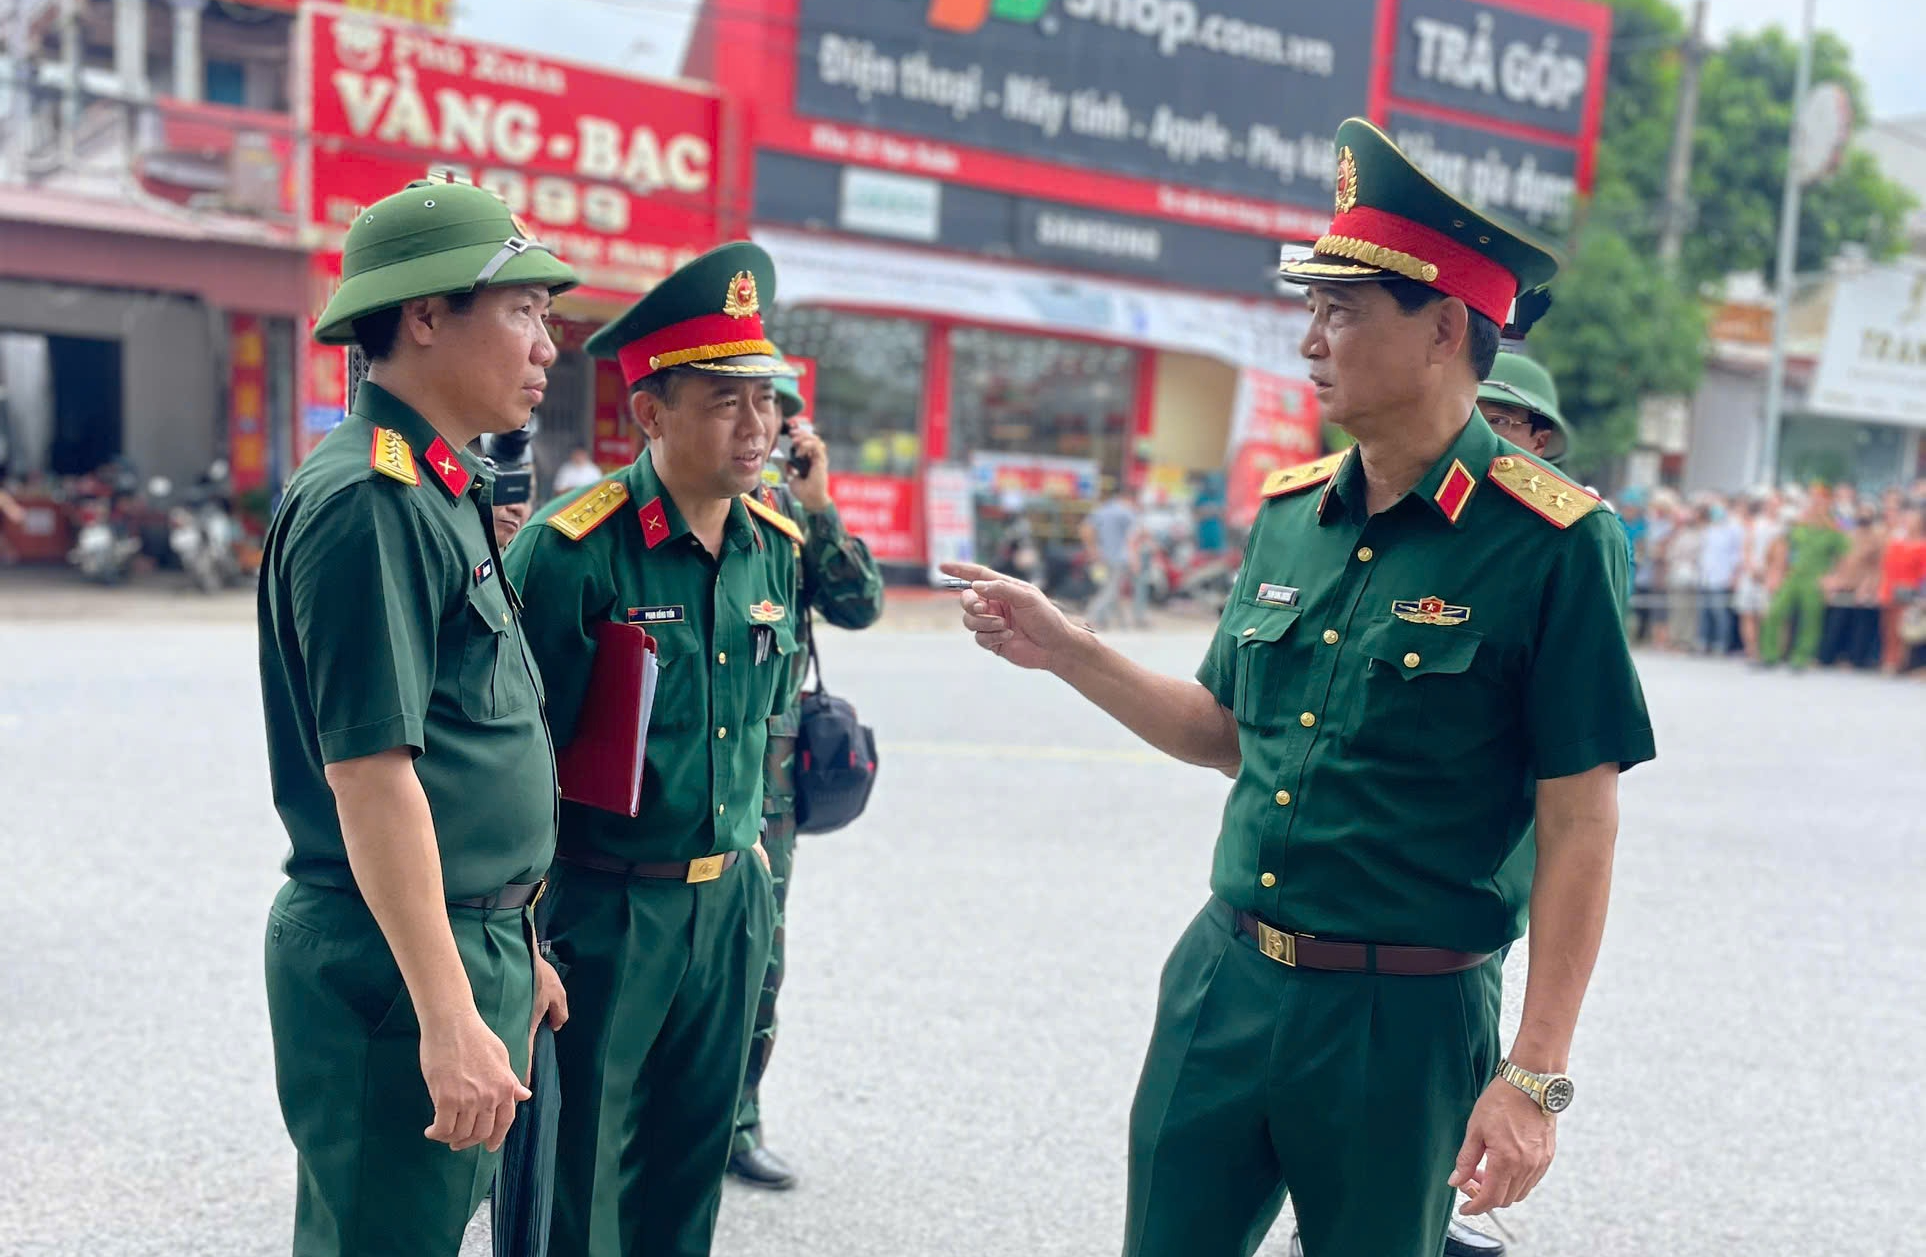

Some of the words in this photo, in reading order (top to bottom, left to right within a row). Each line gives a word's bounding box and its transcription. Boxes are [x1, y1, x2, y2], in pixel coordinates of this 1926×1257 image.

[818, 33, 896, 104] Điện
[1003, 72, 1067, 138] Máy
[1149, 104, 1231, 164] Apple
[1413, 12, 1496, 94] TRẢ
[331, 66, 541, 162] VÀNG
[577, 116, 710, 193] BẠC
[1037, 211, 1162, 262] SAMSUNG
